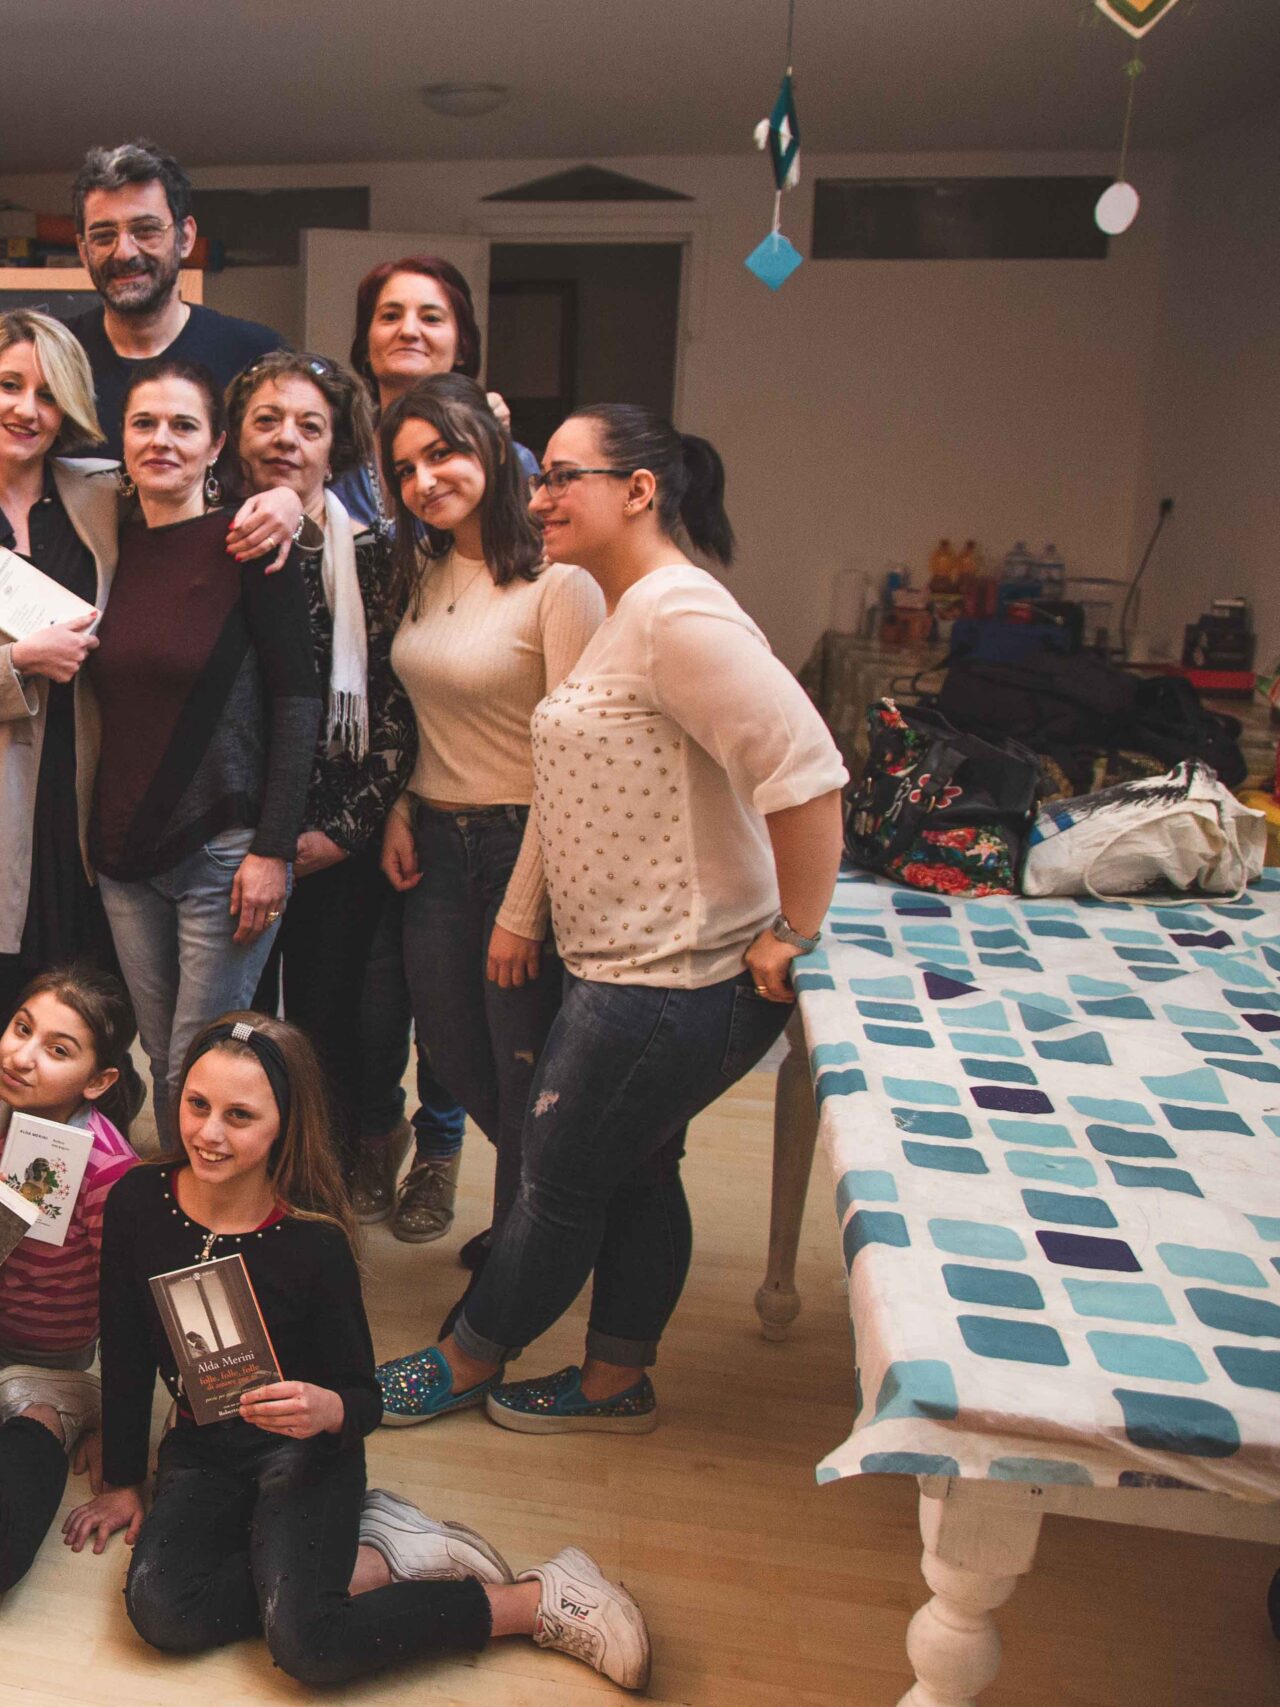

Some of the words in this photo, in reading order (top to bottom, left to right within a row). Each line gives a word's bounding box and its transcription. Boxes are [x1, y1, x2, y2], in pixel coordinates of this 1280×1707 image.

[198, 1360, 220, 1374] Alda
[222, 1350, 255, 1367] Merini
[561, 1597, 589, 1620] FILA
